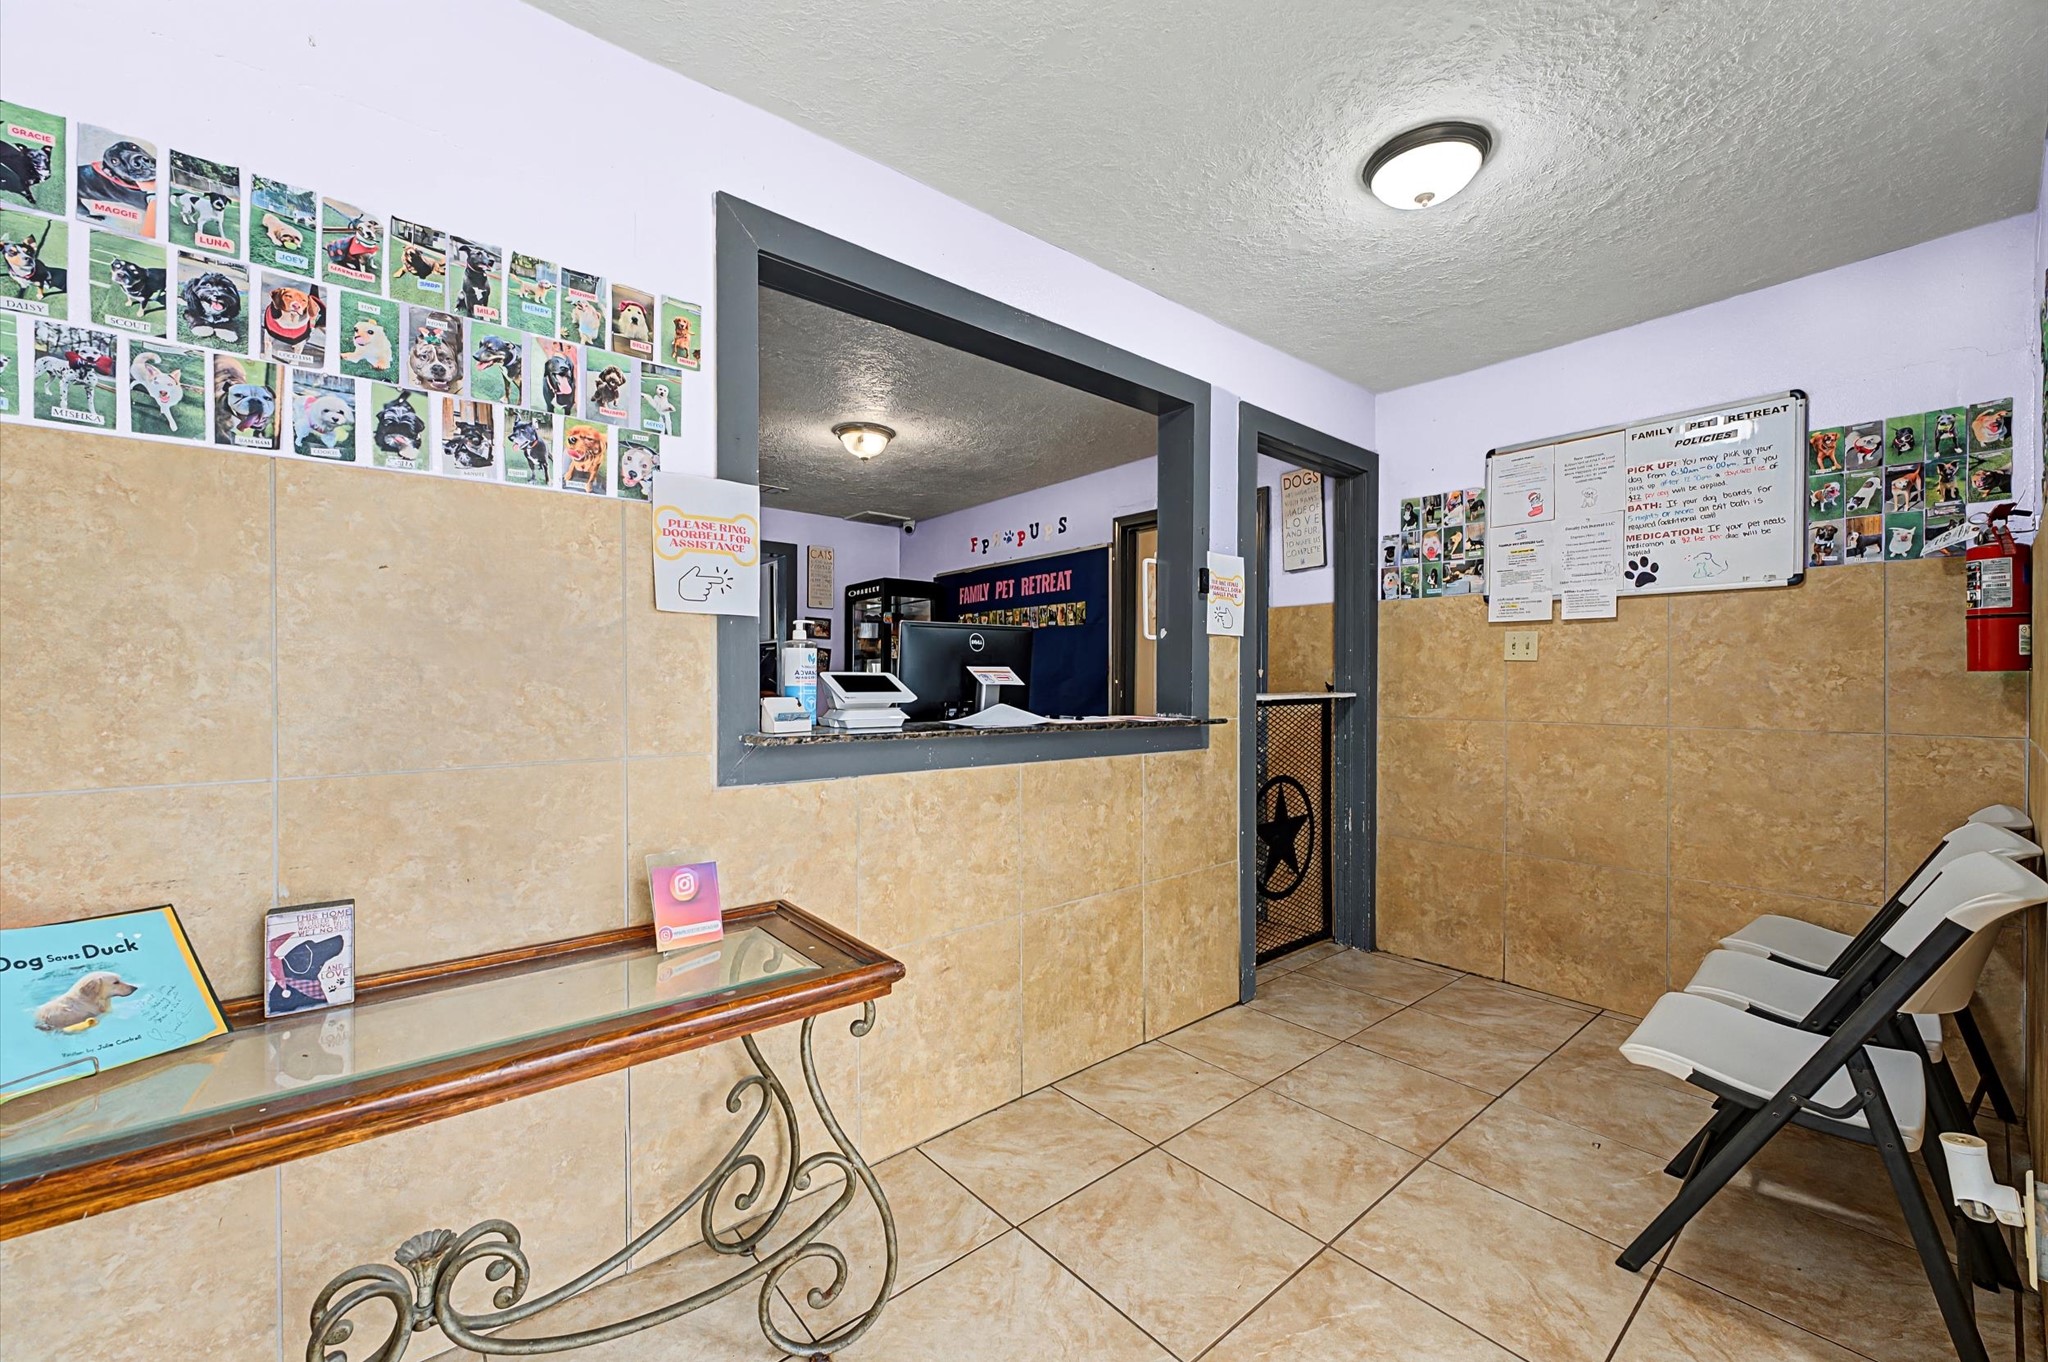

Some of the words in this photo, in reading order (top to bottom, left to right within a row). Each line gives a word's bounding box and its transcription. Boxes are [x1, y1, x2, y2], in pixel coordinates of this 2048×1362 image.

[11, 126, 52, 143] GRACIE
[94, 203, 139, 219] MAGGIE
[199, 236, 230, 249] LUNA
[278, 253, 305, 266] JOEY
[6, 300, 46, 313] DAISY
[110, 316, 149, 331] SCOUT
[52, 407, 103, 423] MISHKA
[1631, 426, 1675, 441] FAMILY
[1689, 419, 1714, 431] PET
[1727, 404, 1790, 423] RETREAT
[1674, 431, 1733, 448] POLICIES
[1626, 463, 1655, 475] PICK
[1657, 461, 1677, 470] UP:
[1699, 454, 1719, 463] may
[1723, 449, 1741, 461] pick
[1742, 448, 1753, 457] up
[1755, 444, 1774, 455] your
[1628, 476, 1643, 484] dog
[1762, 454, 1778, 464] you
[1283, 471, 1319, 491] DOGS
[1627, 501, 1662, 513] BATH:
[1682, 497, 1698, 508] your
[1702, 494, 1717, 503] dog
[1722, 488, 1753, 499] boards
[1698, 505, 1710, 513] an
[1729, 499, 1750, 508] bath
[668, 518, 717, 531] PLEASE
[719, 523, 747, 534] RING
[1285, 513, 1320, 529] LOVE
[662, 527, 727, 541] DOORBELL
[730, 533, 751, 544] FOR
[1286, 529, 1302, 539] AND
[1625, 527, 1704, 543] MEDICATION:
[1725, 522, 1744, 532] your
[1747, 520, 1761, 530] pet
[1763, 516, 1787, 526] needs
[670, 538, 745, 553] ASSISTANCE
[810, 549, 833, 560] CATS
[959, 582, 990, 605] FAMILY
[995, 579, 1015, 600] PET
[1021, 569, 1073, 597] RETREAT
[296, 913, 318, 922] THIS
[321, 908, 352, 919] HOME
[46, 953, 80, 962] Saves
[81, 938, 139, 959] Duck
[320, 968, 349, 980] LOVE
